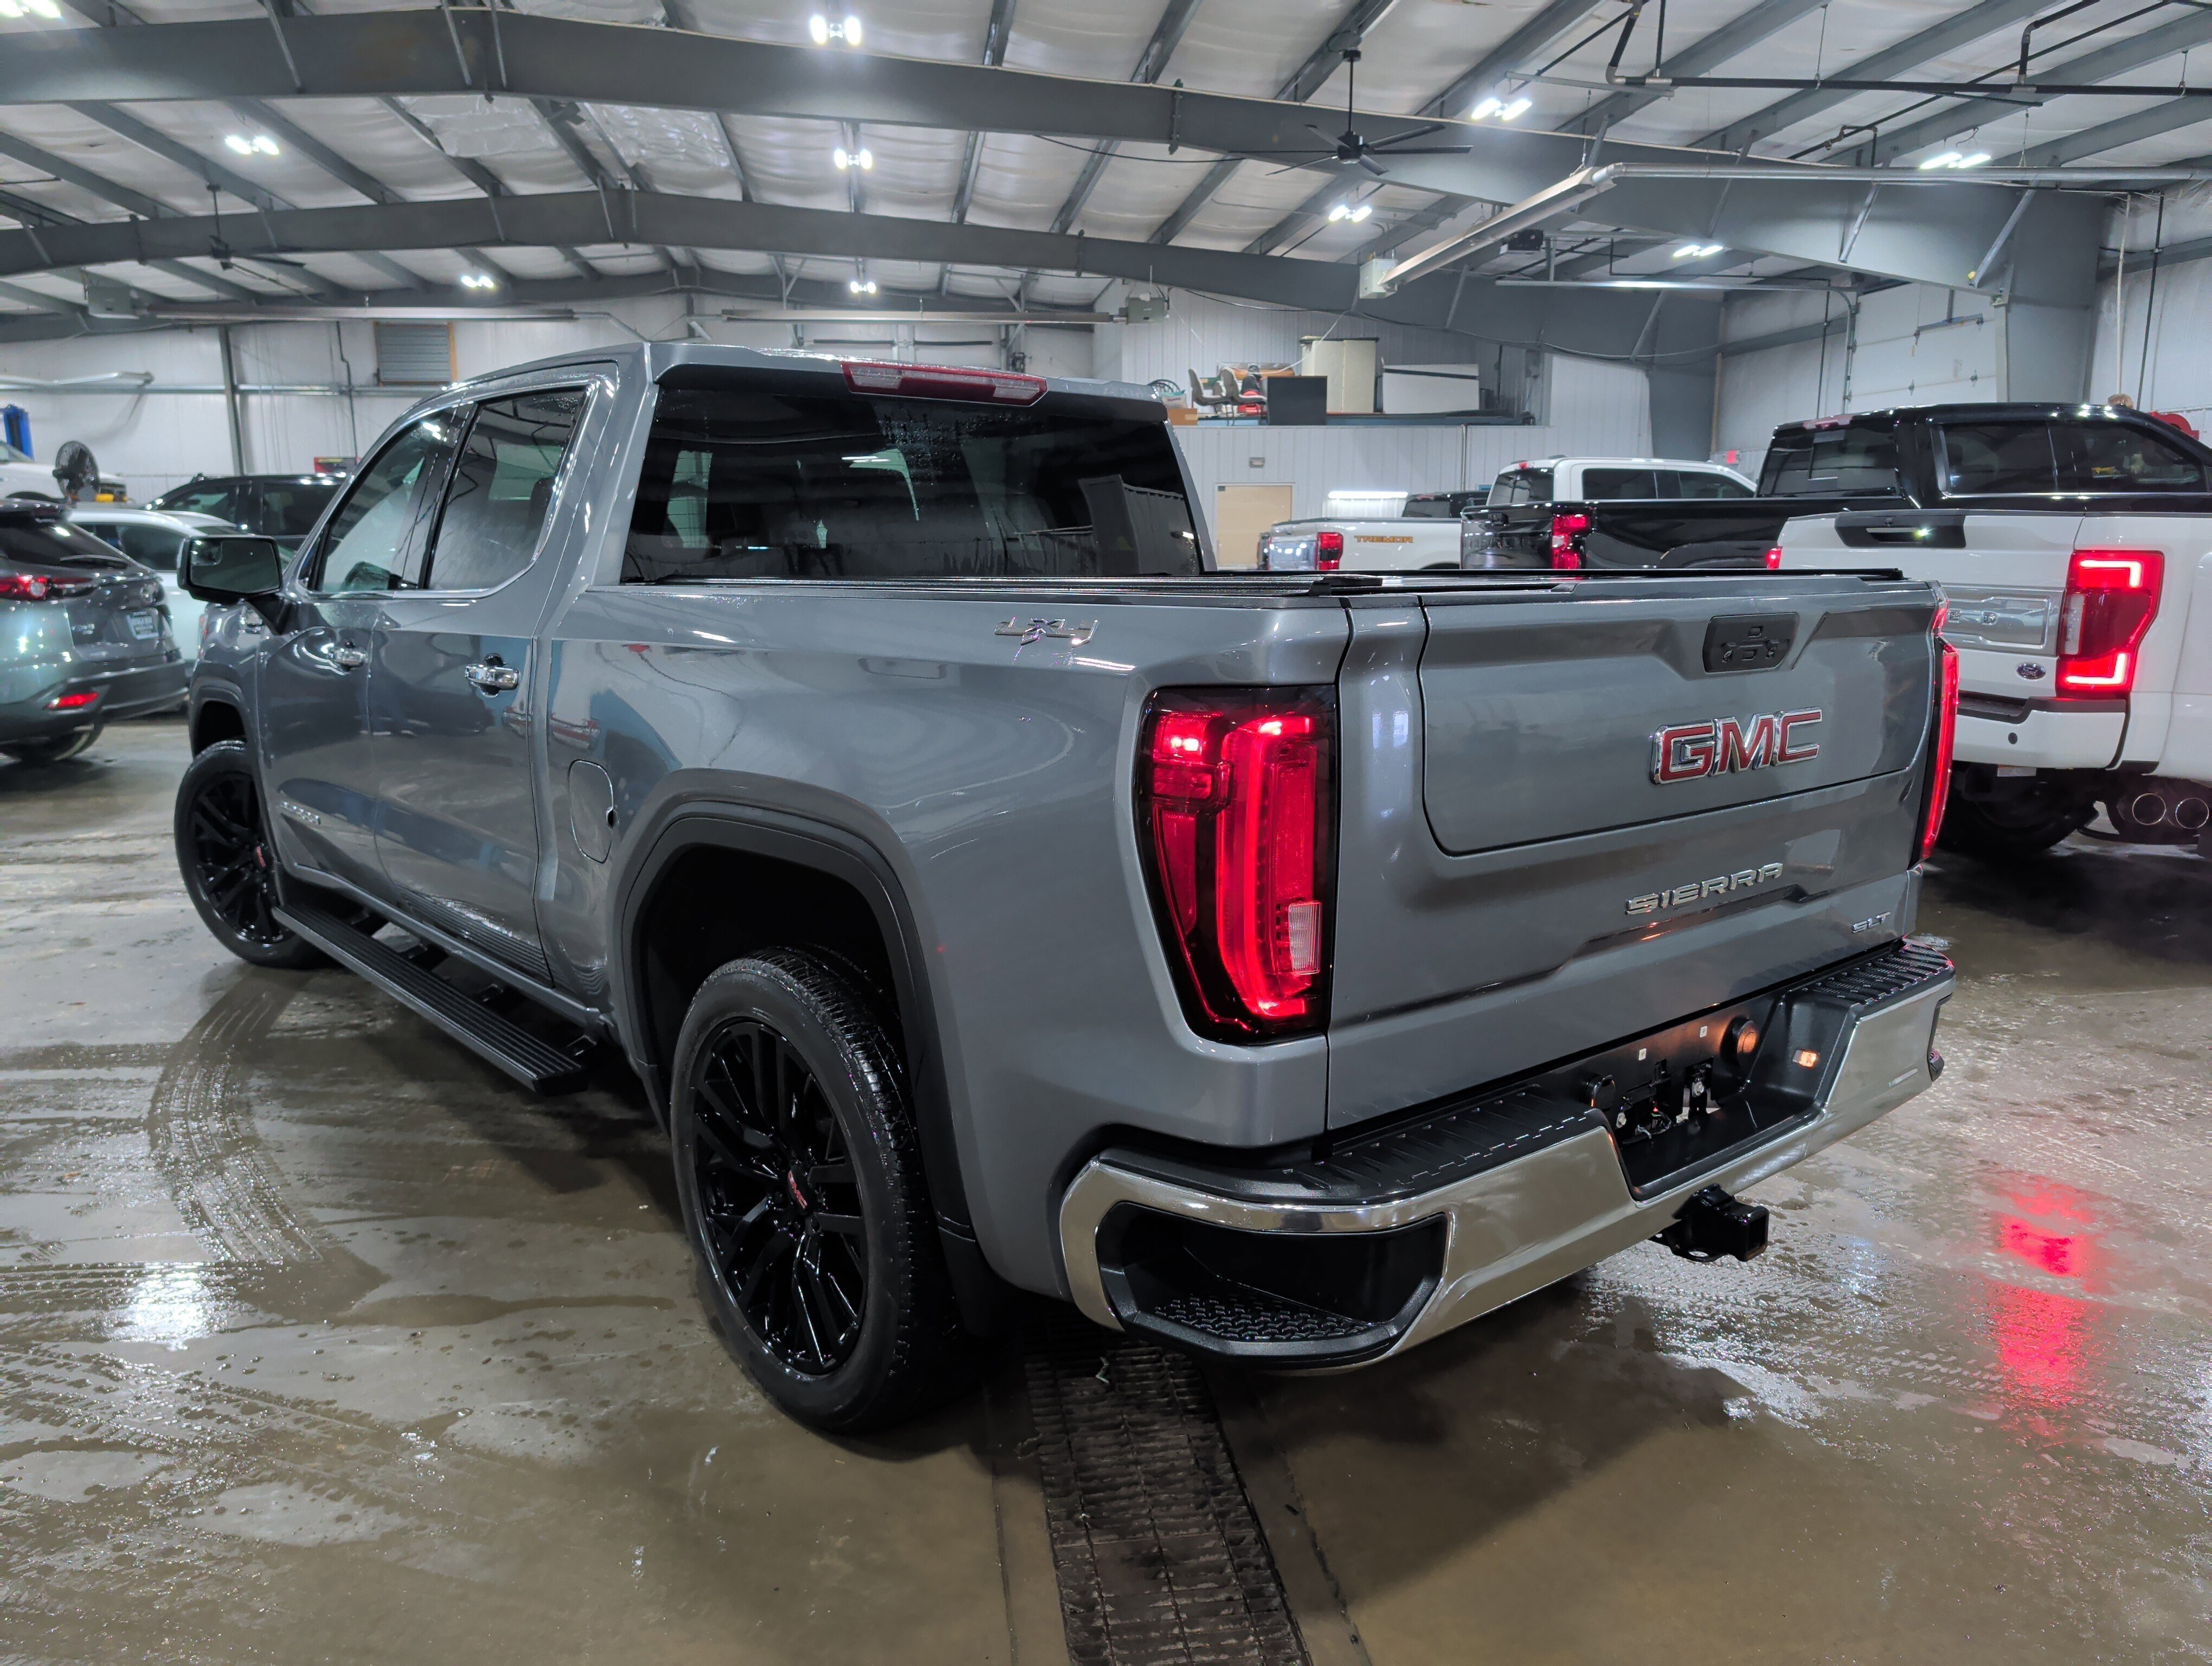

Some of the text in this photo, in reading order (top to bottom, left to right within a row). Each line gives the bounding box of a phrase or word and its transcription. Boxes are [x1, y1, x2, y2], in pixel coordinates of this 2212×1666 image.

[1649, 706, 1822, 784] GMC
[1625, 862, 1783, 915] SIERRA
[1852, 912, 1891, 933] SLT
